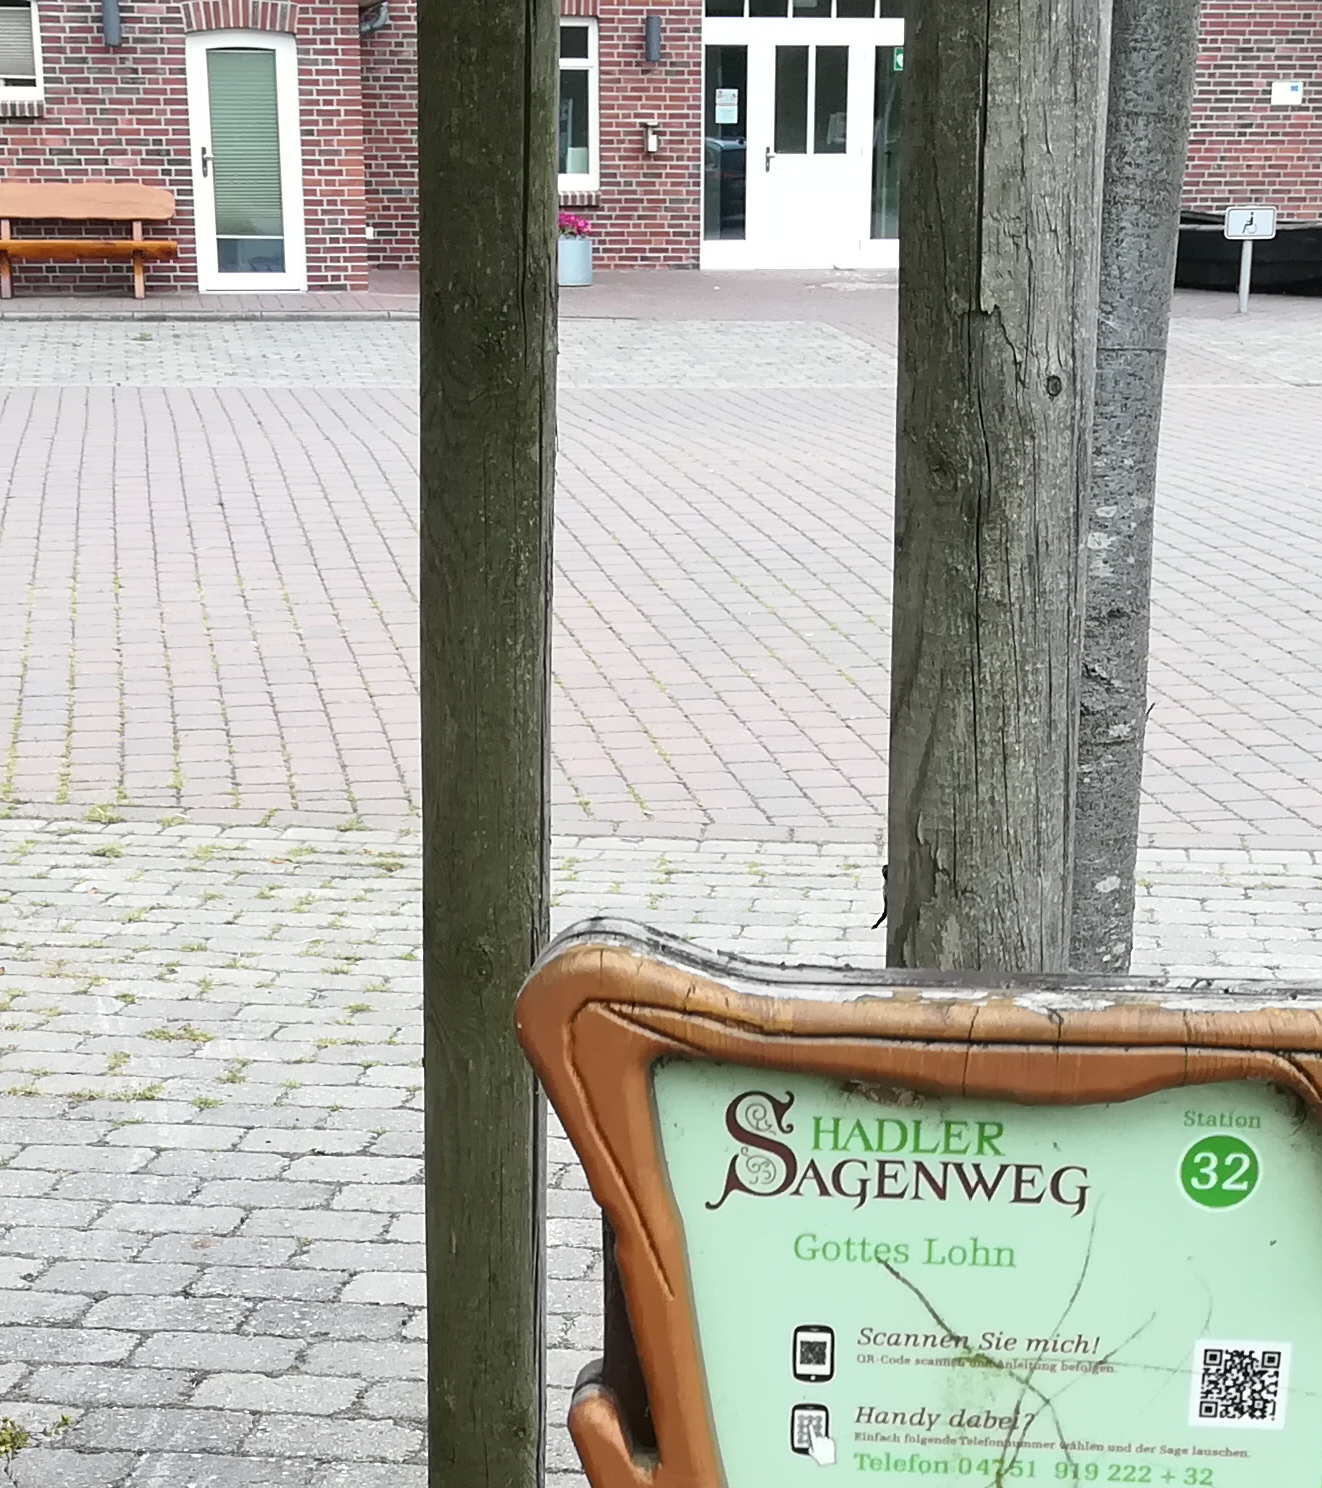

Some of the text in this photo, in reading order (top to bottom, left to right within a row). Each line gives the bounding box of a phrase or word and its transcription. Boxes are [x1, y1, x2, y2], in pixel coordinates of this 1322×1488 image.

[1183, 1110, 1261, 1129] Station
[812, 1116, 1005, 1156] HADLER
[705, 1090, 1091, 1218] SAGENWEG
[1190, 1151, 1251, 1191] 32
[793, 1233, 1016, 1268] Gottes Lohn
[857, 1327, 1101, 1355] Scannen Sie mich!
[997, 1359, 1056, 1374] Anleitung
[854, 1406, 1035, 1435] Handy dabei?
[854, 1432, 1252, 1458] Einfach folgende Telefonnummer wählen und der Sage lauschen.
[854, 1452, 949, 1475] Telefon
[1054, 1462, 1099, 1481] 919
[1107, 1464, 1152, 1483] 222
[1160, 1470, 1176, 1484] +
[1183, 1467, 1214, 1486] 32
